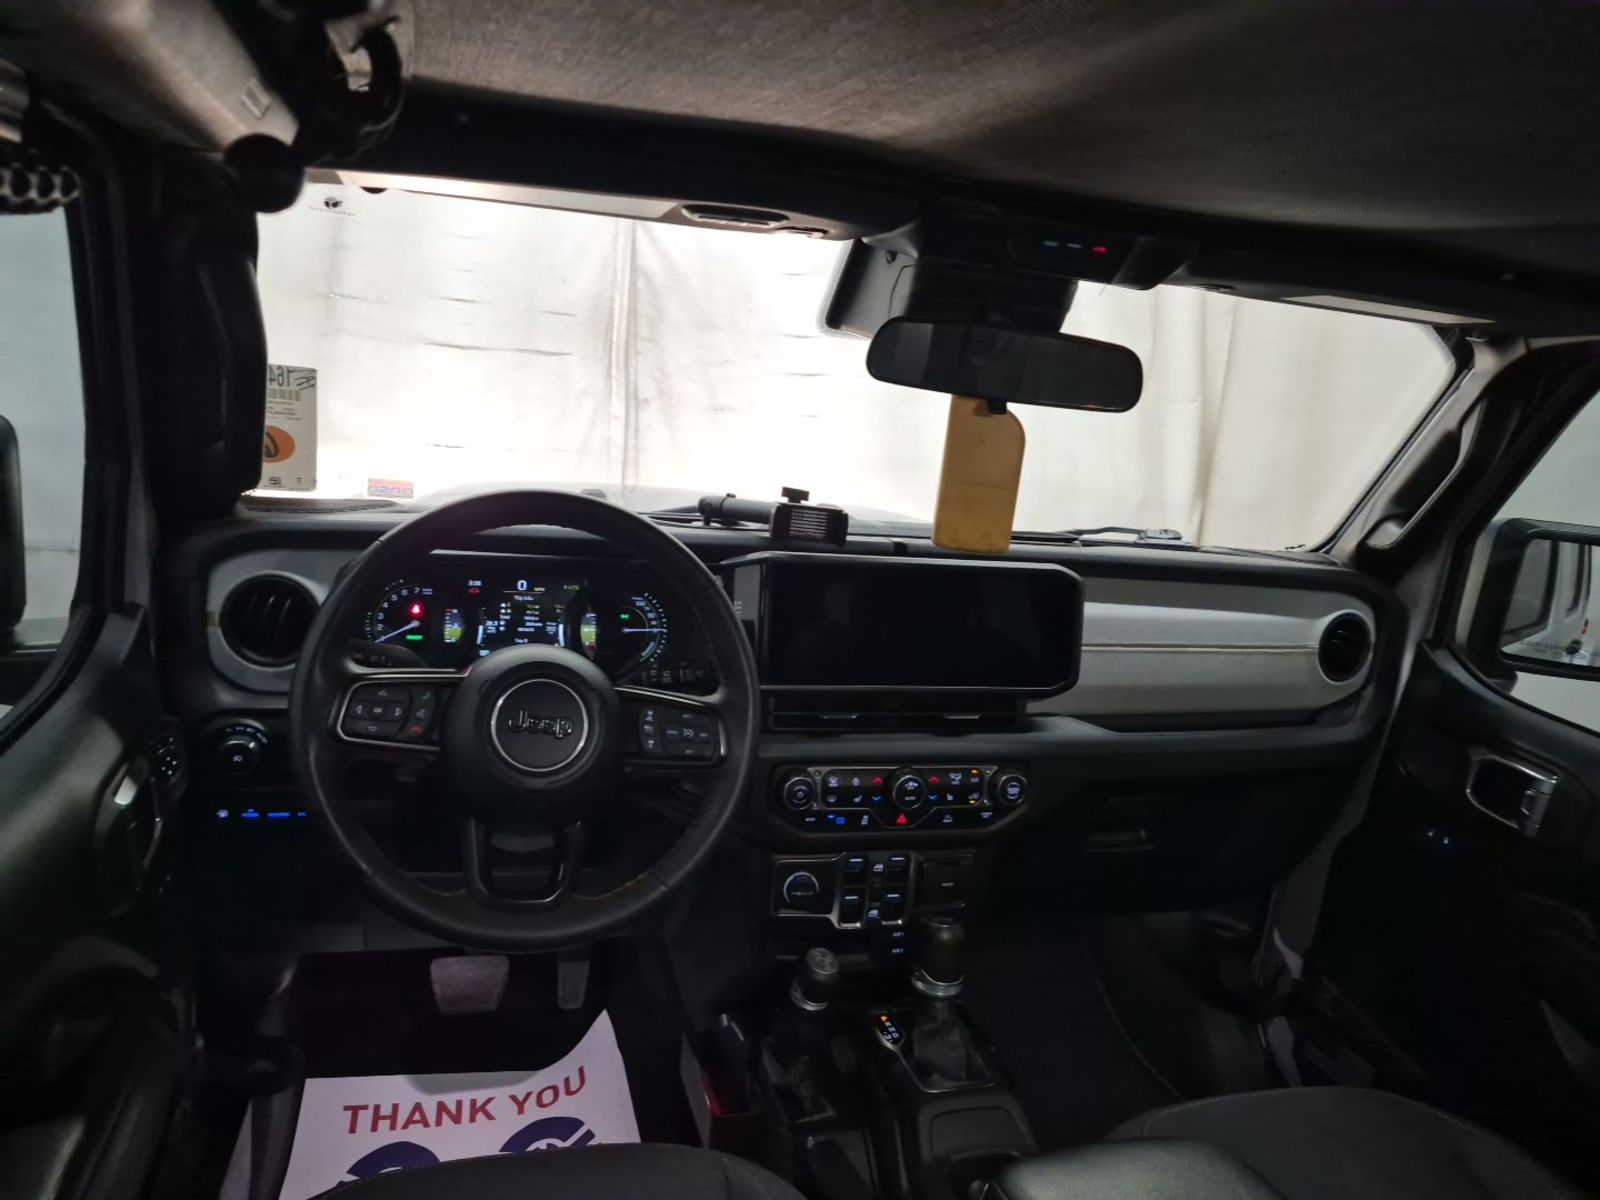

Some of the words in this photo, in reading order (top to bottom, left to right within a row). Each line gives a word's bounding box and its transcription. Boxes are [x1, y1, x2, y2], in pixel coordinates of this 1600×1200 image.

[517, 580, 527, 591] 0
[508, 710, 574, 738] Jeep
[343, 1096, 496, 1134] THANK
[508, 1065, 587, 1116] YOU
